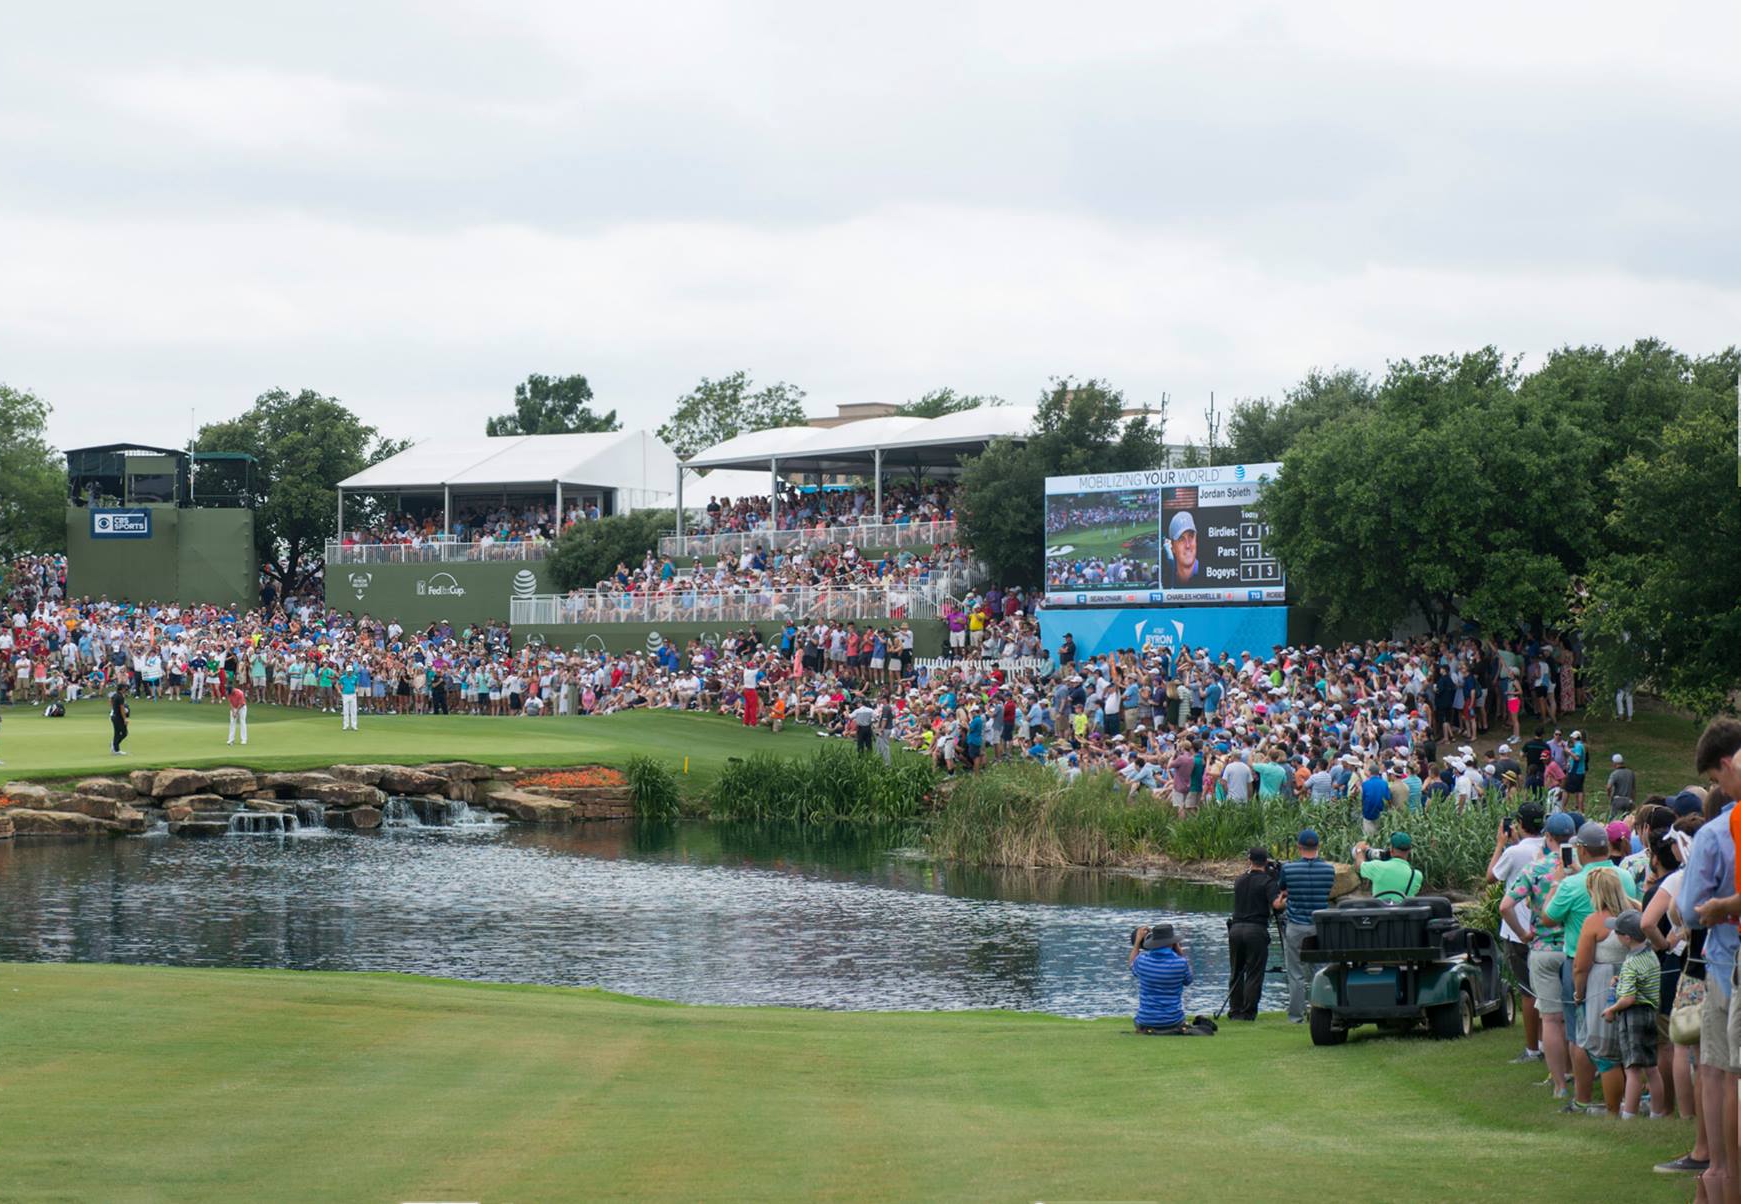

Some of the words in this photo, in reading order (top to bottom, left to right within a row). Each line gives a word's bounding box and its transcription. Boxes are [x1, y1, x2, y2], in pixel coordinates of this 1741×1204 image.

[1079, 473, 1142, 490] MOBILIZING
[1144, 471, 1176, 485] YOUR
[1178, 468, 1220, 484] WORLD
[1200, 489, 1226, 499] Jordan
[1227, 487, 1251, 499] Spieth
[1208, 526, 1239, 538] Birdies:
[1247, 526, 1253, 537] 4
[1217, 546, 1239, 557] Pars:
[1245, 546, 1255, 557] 11
[1206, 566, 1239, 579] Bogeys:
[1247, 566, 1253, 577] 1
[1267, 565, 1273, 577] 3
